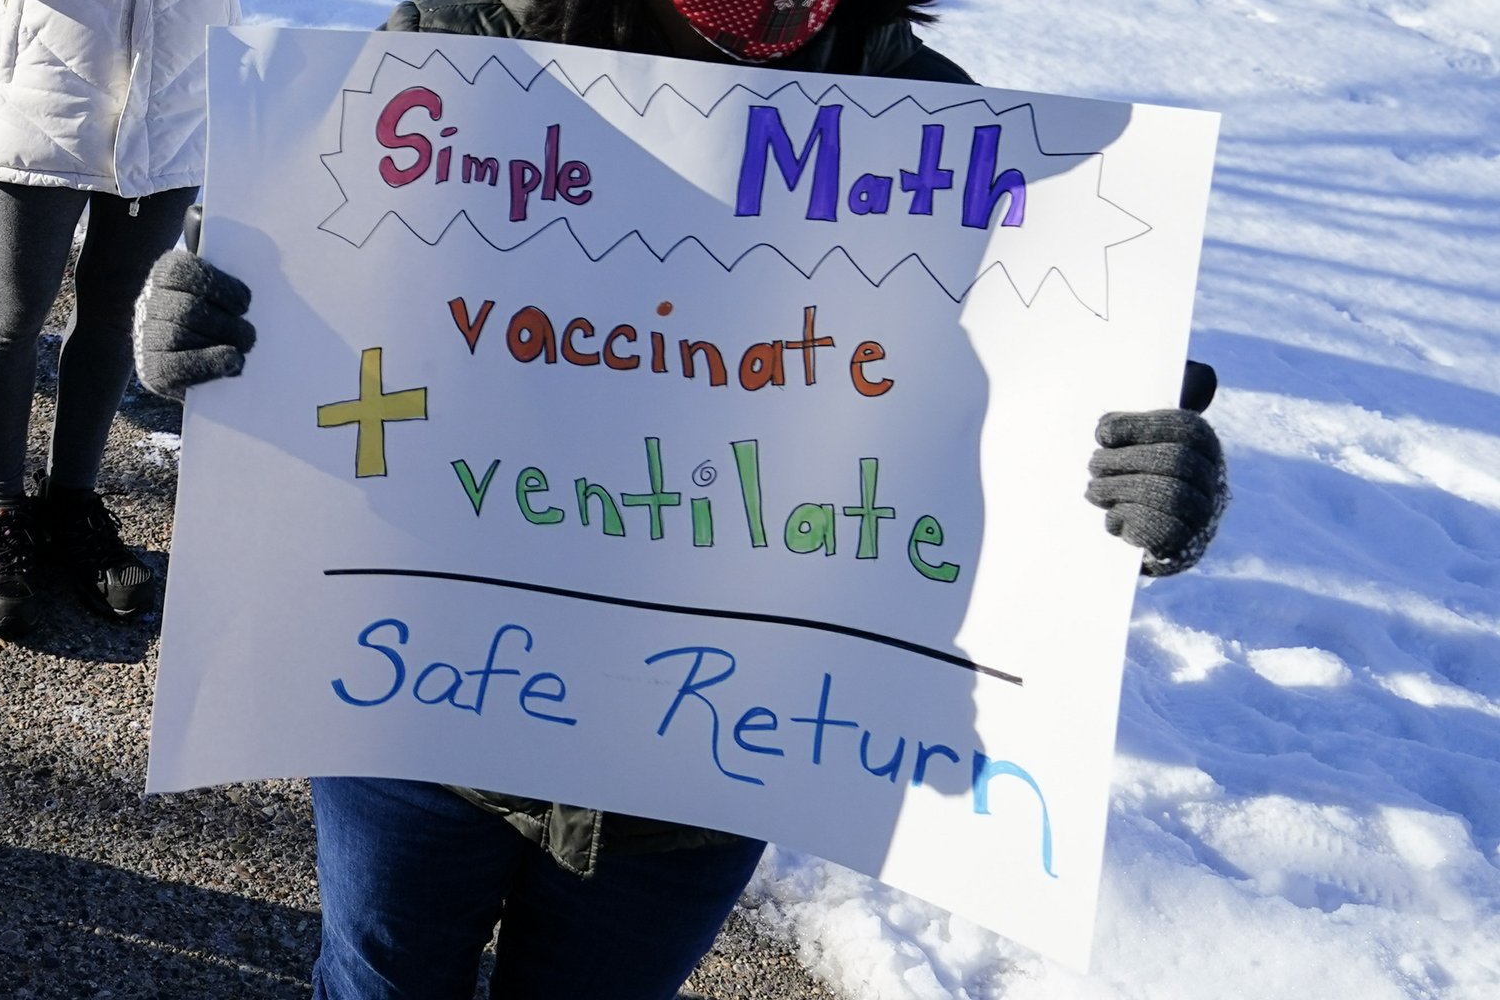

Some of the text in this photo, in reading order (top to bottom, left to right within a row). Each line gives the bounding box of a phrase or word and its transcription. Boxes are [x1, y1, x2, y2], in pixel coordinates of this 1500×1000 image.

[375, 86, 1029, 230] Simple Math
[447, 297, 896, 398] vaccinate
[450, 435, 961, 584] ventilate
[331, 617, 1061, 880] Safe Return
